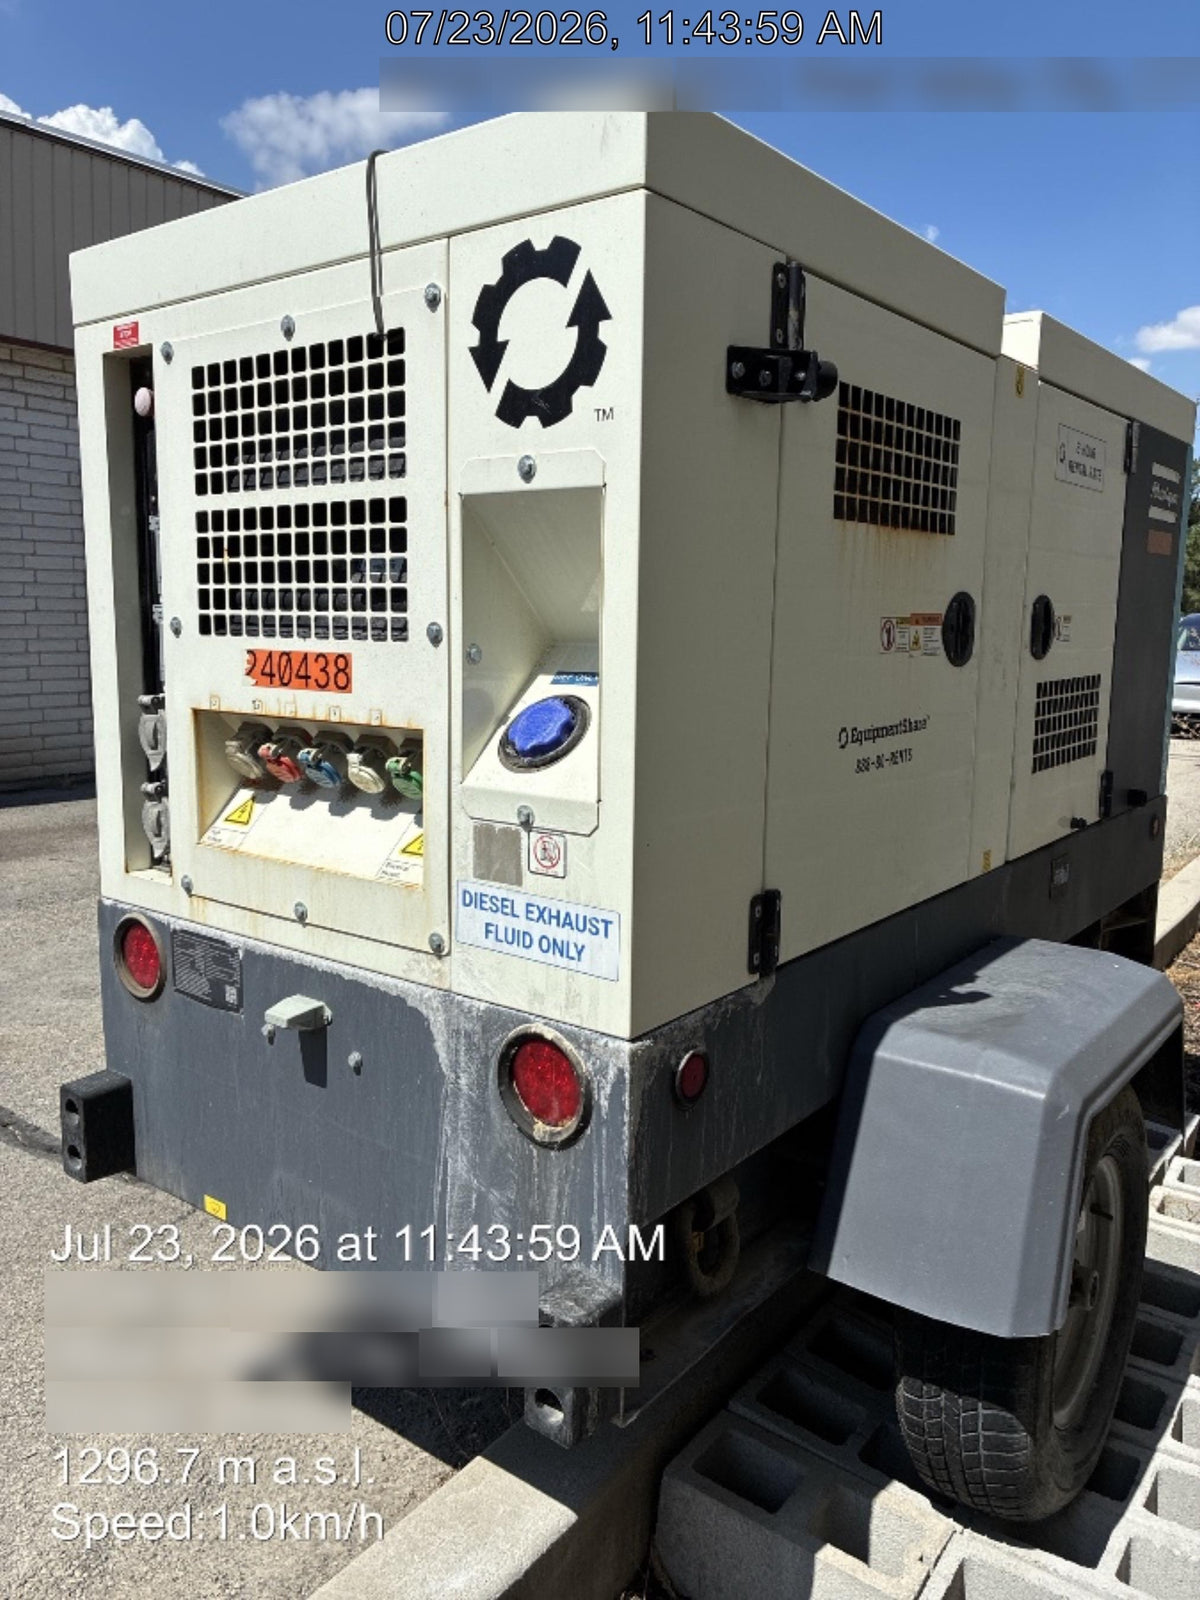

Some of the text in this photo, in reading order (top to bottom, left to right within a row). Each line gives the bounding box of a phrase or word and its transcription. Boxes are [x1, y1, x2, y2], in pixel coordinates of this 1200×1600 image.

[593, 407, 614, 422] TM
[462, 889, 613, 939] DIESEL EXHAUST
[484, 922, 585, 962] FLUID ONLY
